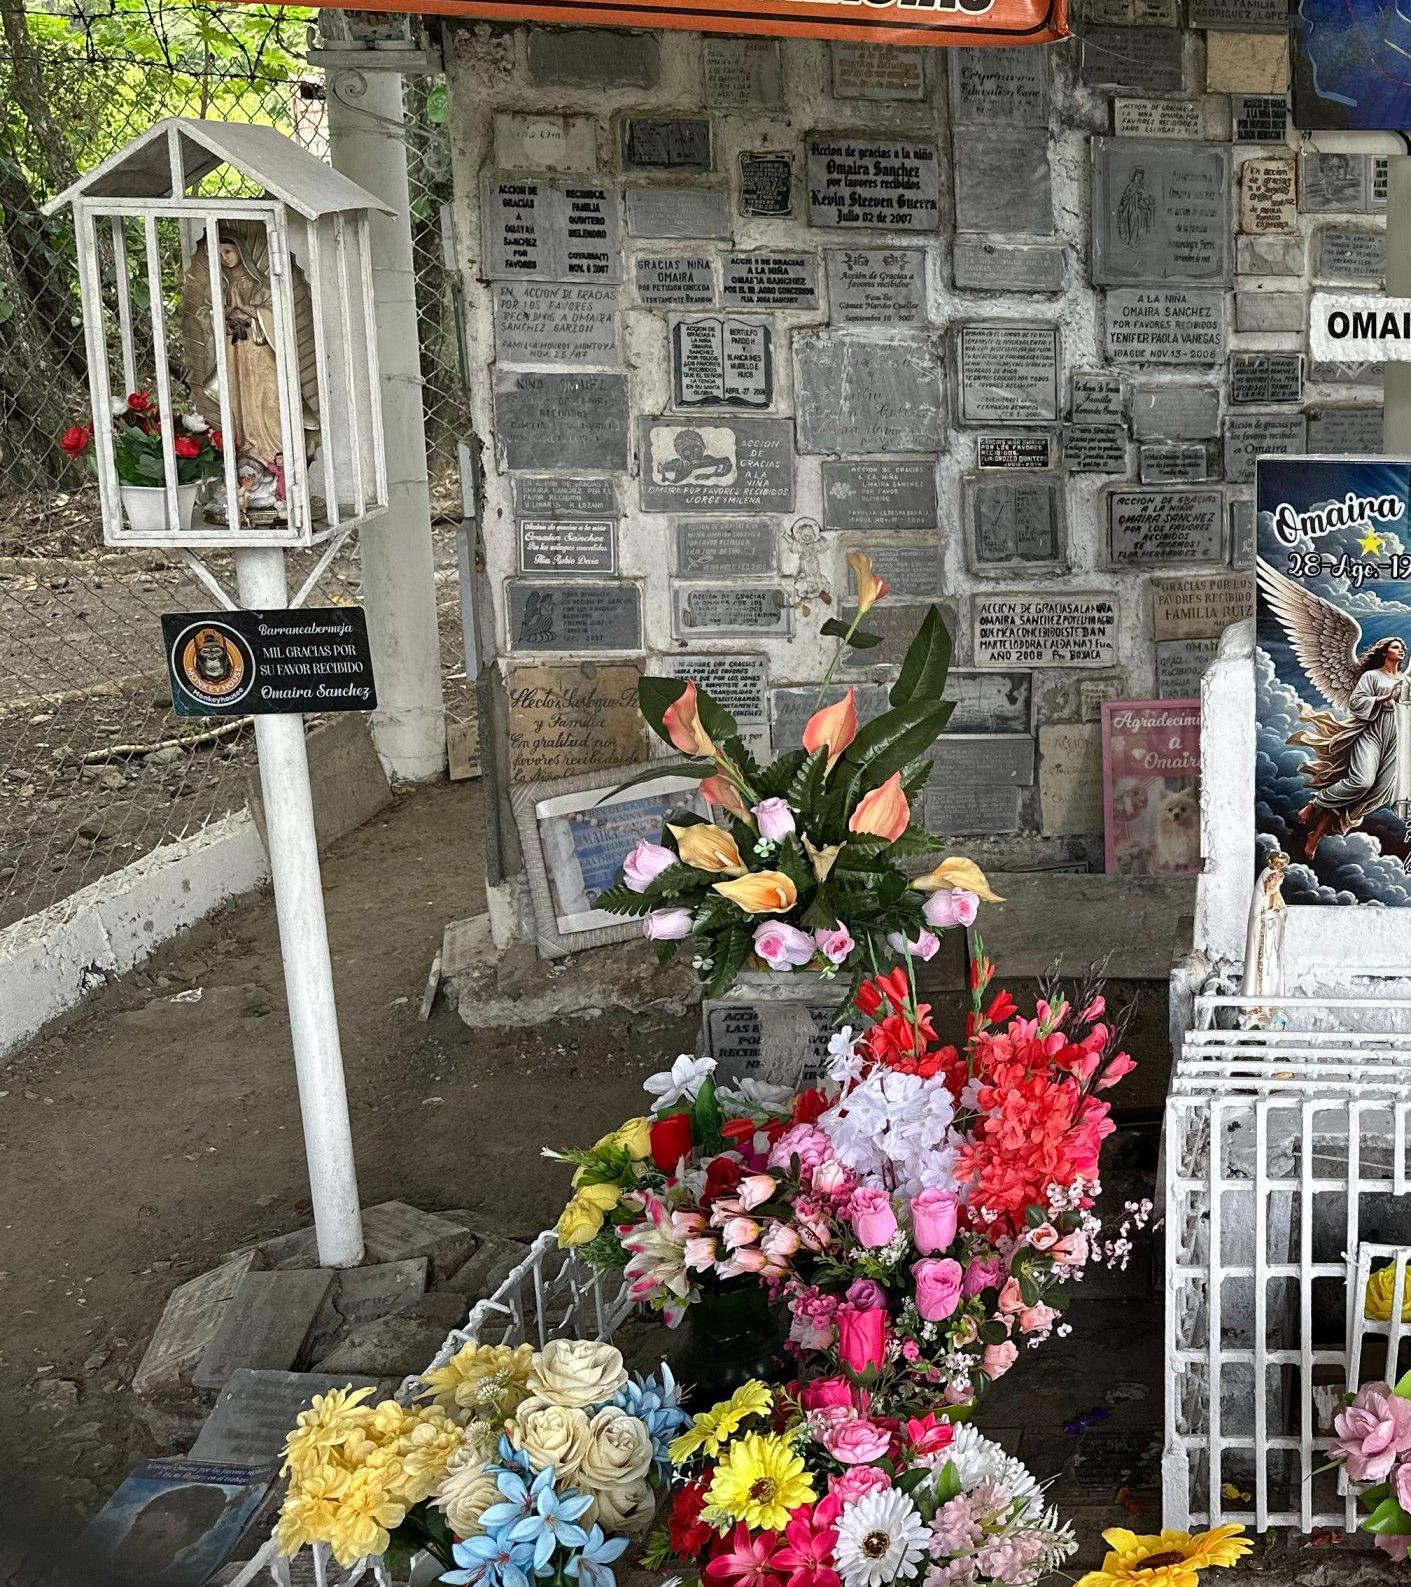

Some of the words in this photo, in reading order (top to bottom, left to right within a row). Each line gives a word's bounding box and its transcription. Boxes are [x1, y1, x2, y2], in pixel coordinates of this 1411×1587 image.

[826, 159, 870, 176] Omaira
[873, 159, 920, 178] Sanchez
[890, 214, 912, 224] 2007
[637, 260, 680, 270] GRACIAS
[687, 258, 710, 270] NIÑA
[657, 272, 694, 282] OMAIRA
[1137, 295, 1144, 303] A
[1147, 295, 1160, 303] LA
[1165, 293, 1187, 303] NIÑA
[1123, 307, 1160, 316] OMAIRA
[1165, 307, 1211, 317] SANCHEZ
[1134, 321, 1171, 329] FAVORES
[1175, 321, 1217, 329] RECIBIDOS
[1111, 332, 1149, 343] YENIFER
[1151, 333, 1179, 344] PAOLA
[1181, 333, 1220, 344] VANEGAS
[1119, 514, 1161, 525] OMAIRA
[1163, 513, 1215, 523] SANCHEZ
[1273, 492, 1405, 547] Omaira
[1165, 607, 1217, 620] FAMILIA
[1223, 605, 1253, 617] RUIZ
[258, 623, 353, 636] Barrancabermeja
[263, 647, 285, 659] MIL
[286, 646, 332, 658] GRACIAS
[335, 645, 356, 656] POR
[260, 664, 275, 676] SU
[277, 663, 311, 675] FAVOR
[313, 662, 363, 674] RECIBIDO
[186, 668, 220, 692] MONKEY
[261, 685, 314, 699] Omaira
[317, 683, 372, 700] Sanchez
